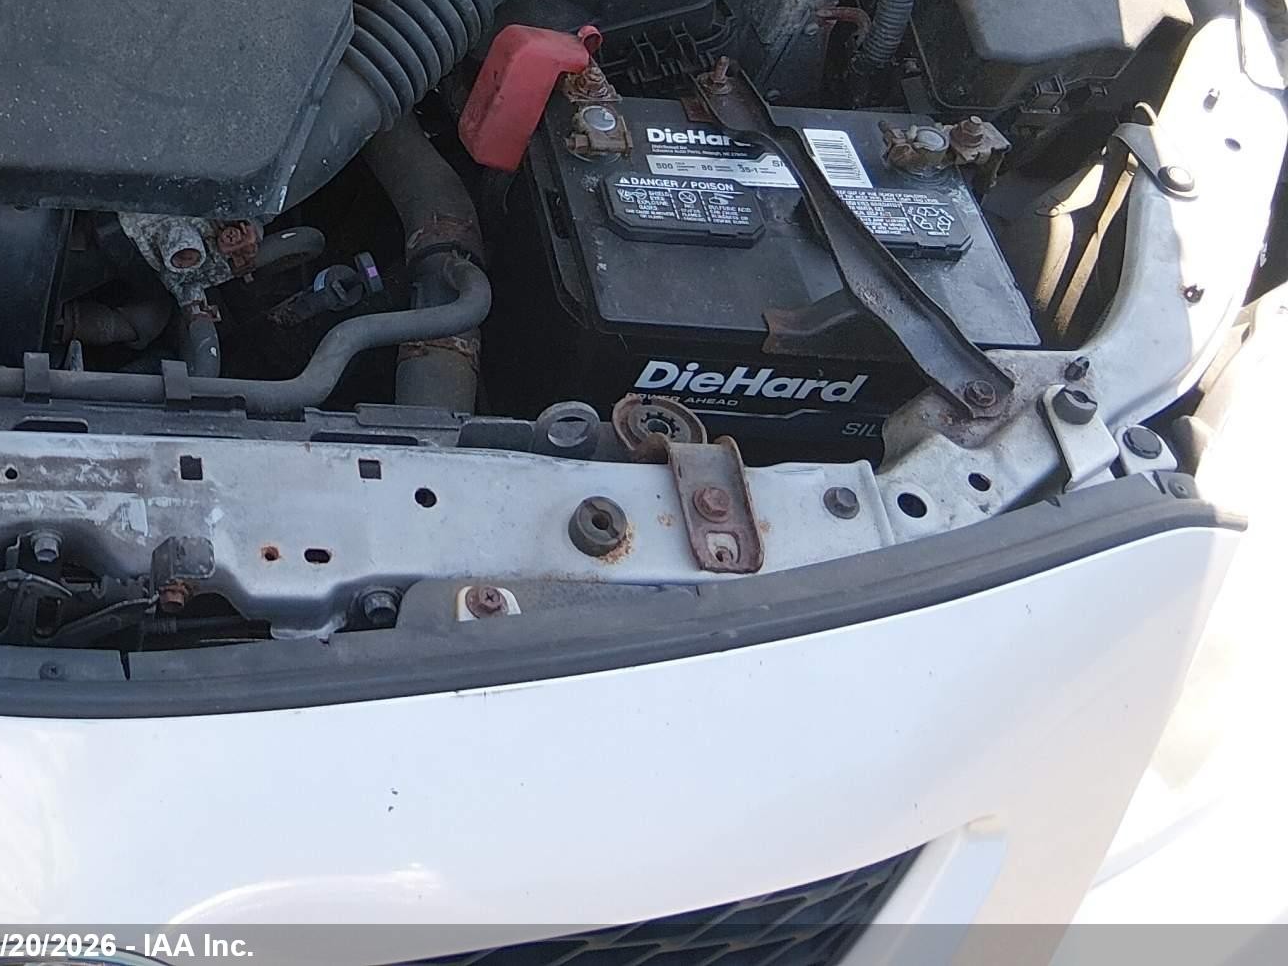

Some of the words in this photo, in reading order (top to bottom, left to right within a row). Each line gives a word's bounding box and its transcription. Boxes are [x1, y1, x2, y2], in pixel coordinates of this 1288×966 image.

[631, 177, 679, 188] DANGER
[681, 180, 688, 188] /
[690, 181, 734, 191] POISON
[634, 360, 869, 403] DieHard
[683, 396, 739, 406] AHEAD
